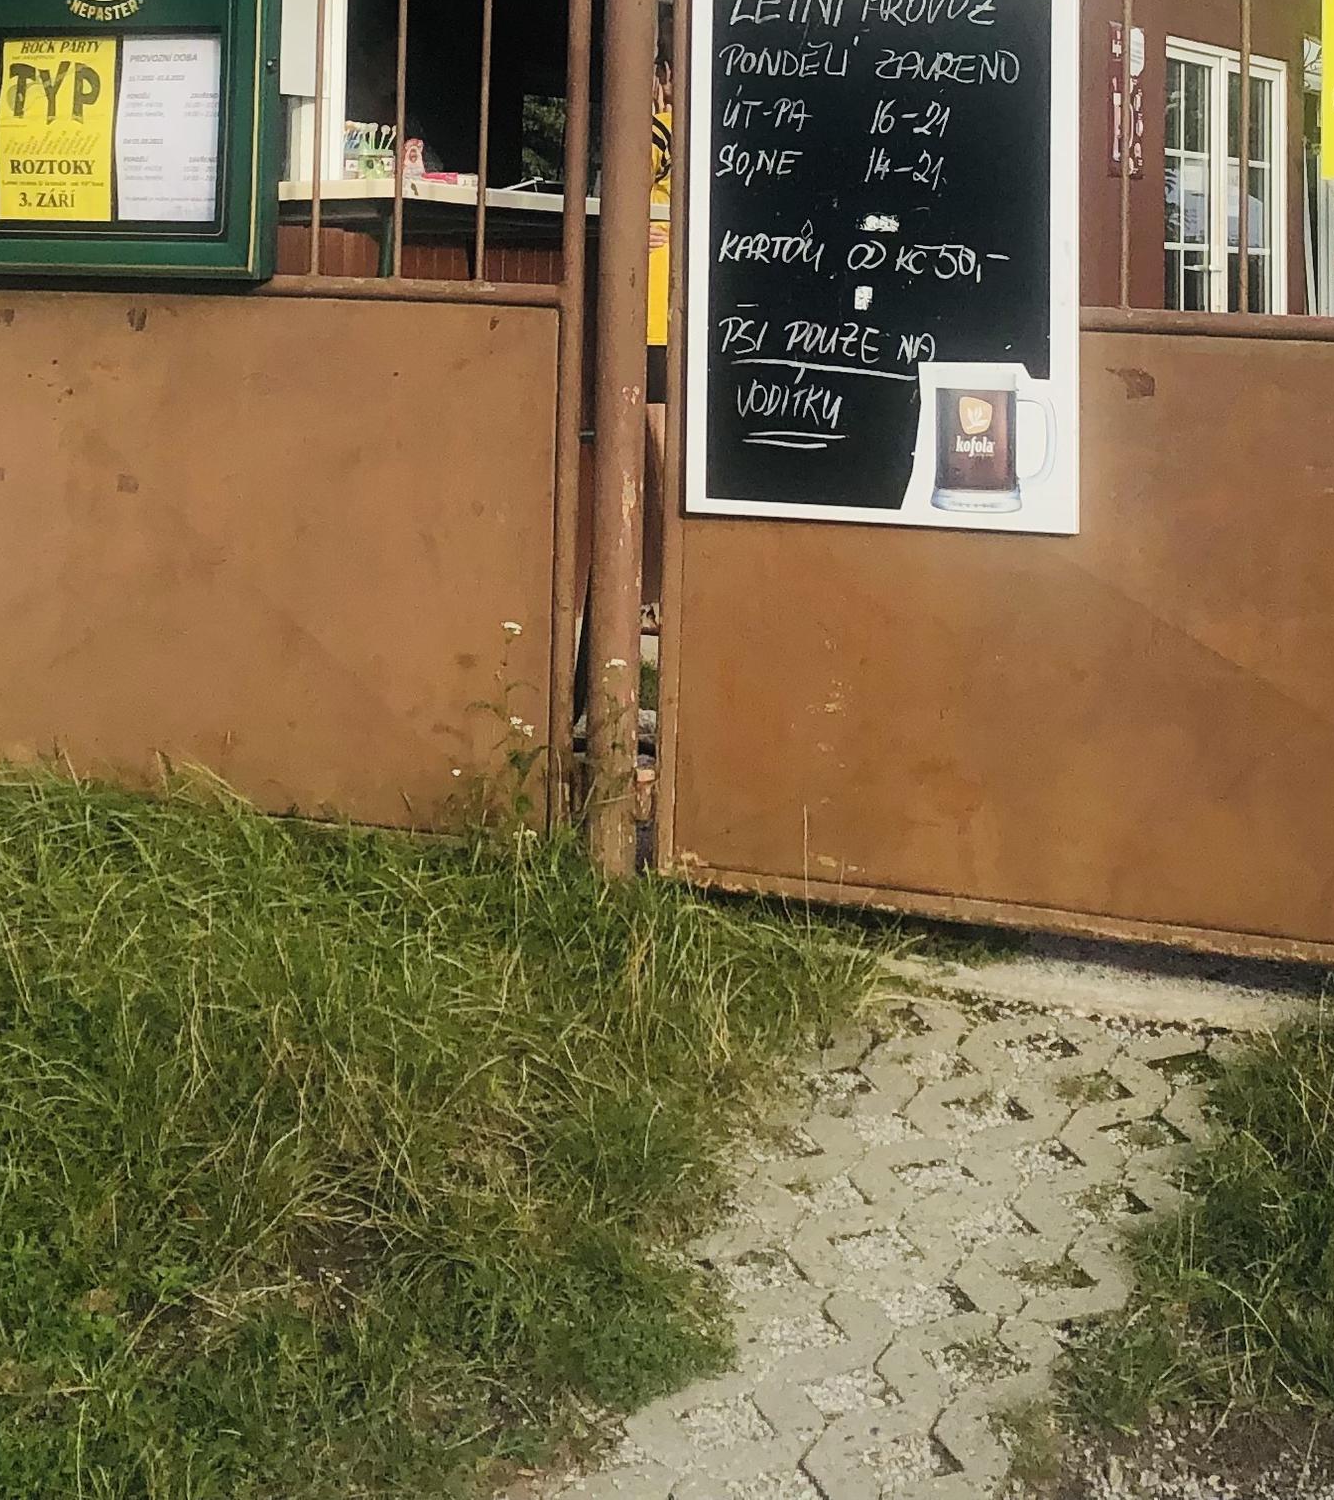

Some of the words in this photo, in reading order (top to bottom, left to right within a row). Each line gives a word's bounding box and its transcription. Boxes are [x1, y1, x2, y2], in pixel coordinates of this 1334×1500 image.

[70, 0, 140, 21] NEPASTER
[60, 40, 101, 53] PARTY
[9, 61, 101, 125] TYP
[10, 159, 95, 175] ROZTOKY
[18, 191, 32, 207] 3.
[36, 187, 75, 207] ZÁŘÍ
[847, 240, 886, 270] OD
[718, 317, 768, 355] PSI
[784, 320, 880, 363] POUZE
[897, 334, 935, 365] NA
[737, 366, 843, 429] VODÍTKU
[955, 436, 995, 457] kofola
